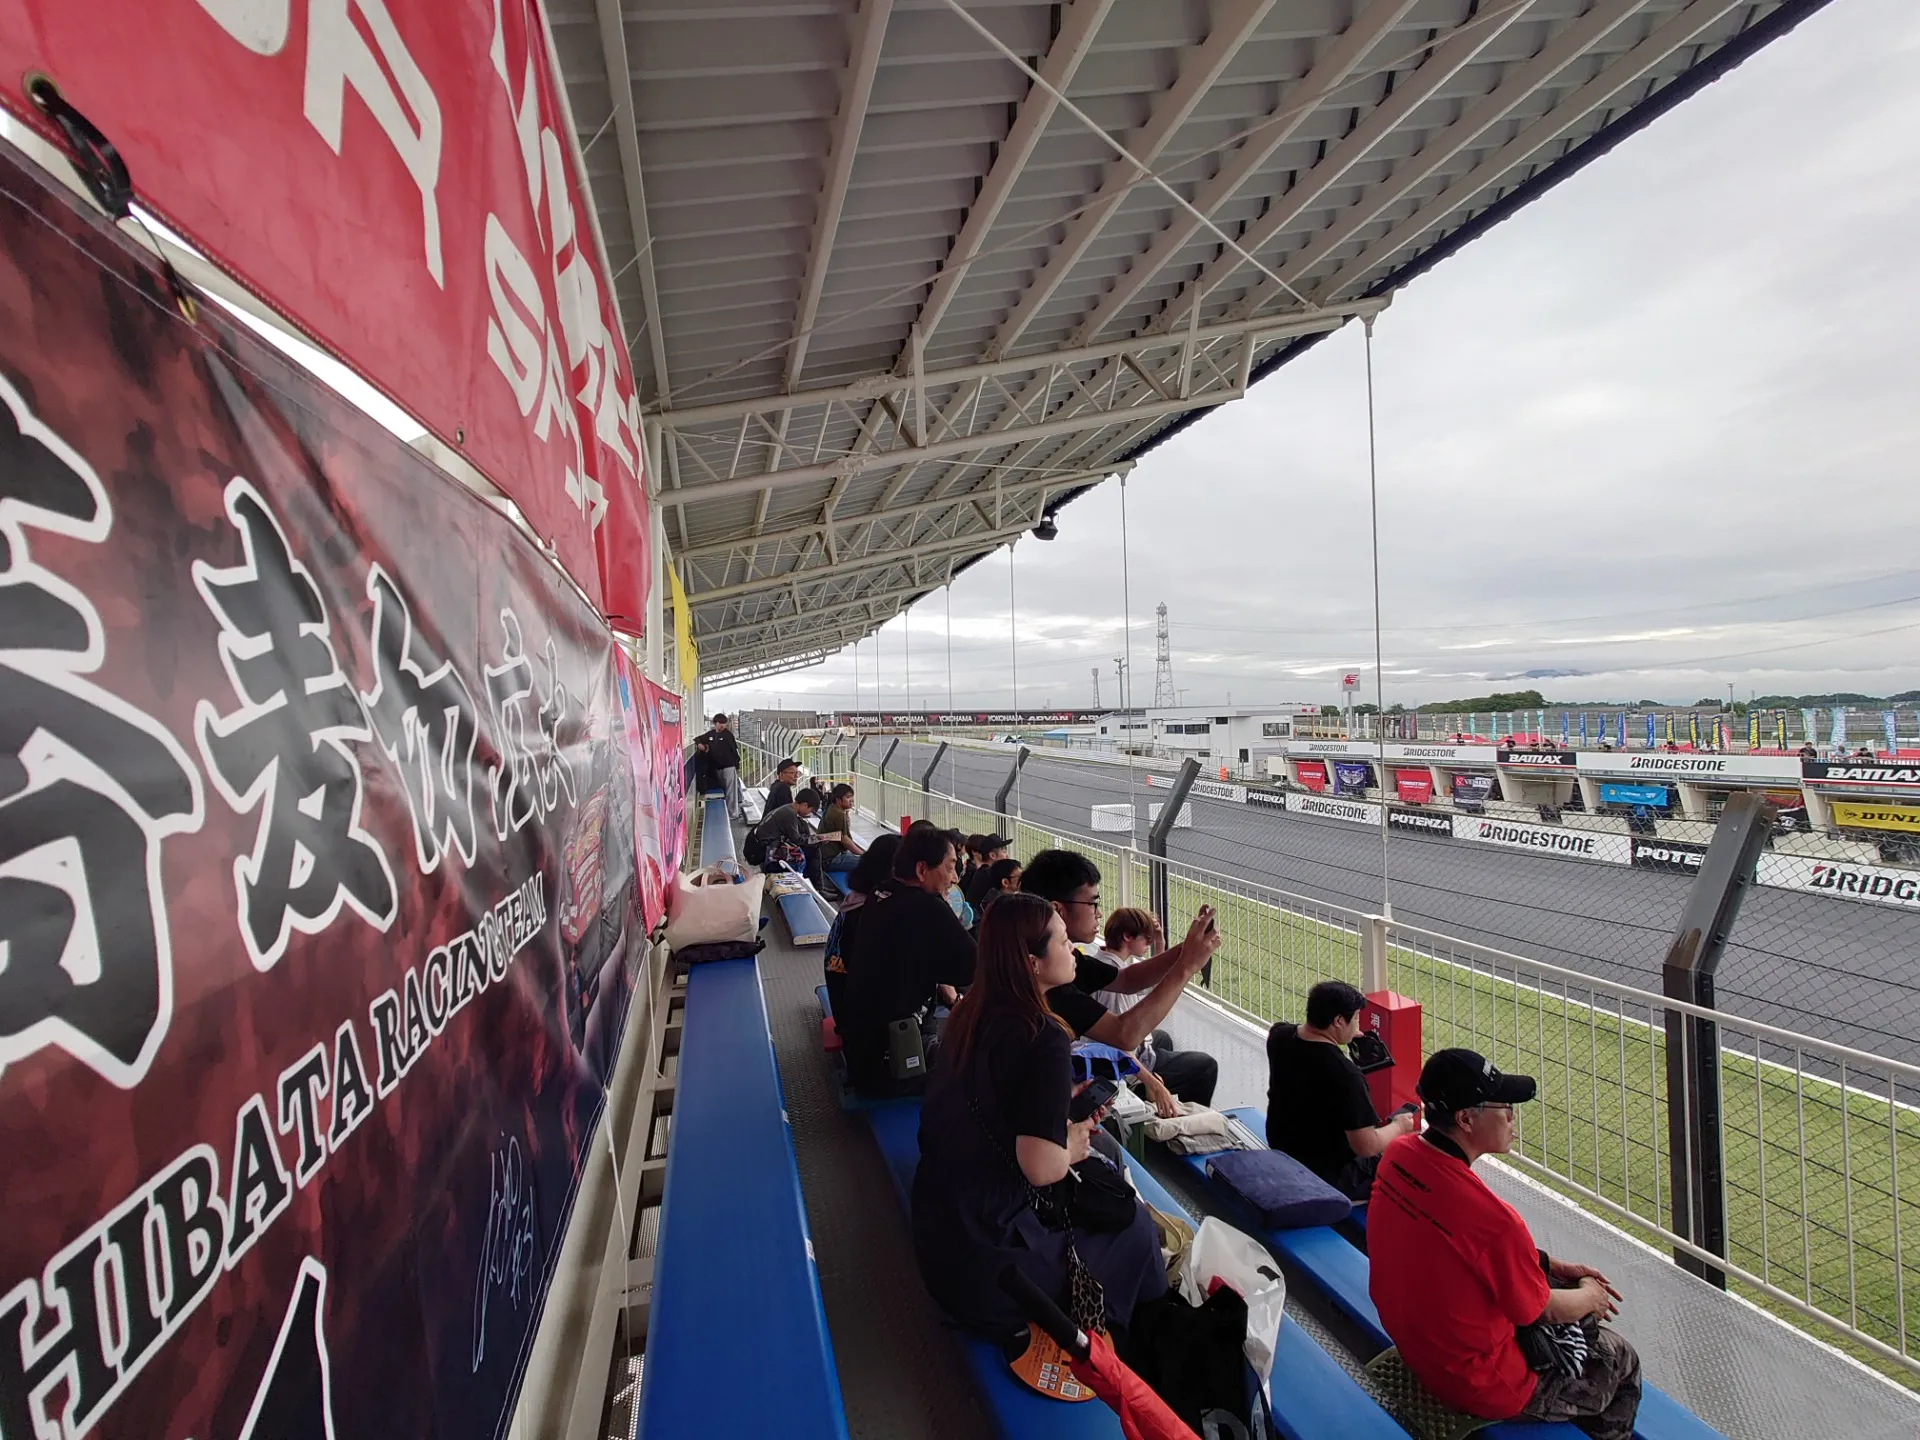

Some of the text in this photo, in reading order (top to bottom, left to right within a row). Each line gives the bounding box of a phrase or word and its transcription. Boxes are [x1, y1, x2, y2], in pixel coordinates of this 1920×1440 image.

[892, 715, 924, 723] YOKOHAMA
[988, 714, 1023, 722] YOKOHAMA
[1309, 743, 1348, 753] BRIDGESTONE
[1403, 747, 1456, 758] BRIDGESTONE
[1630, 756, 1727, 772] BRIDGESTONE
[1247, 792, 1285, 805] POTENZA
[1301, 798, 1368, 820] BRIDGESTONE
[1389, 813, 1451, 830] POTENZA
[1478, 822, 1596, 854] BRIDGESTONE
[1636, 846, 1706, 867] POTE
[1809, 865, 1920, 902] BRIDG
[369, 911, 507, 1099] RACING
[495, 871, 547, 963] TEAM
